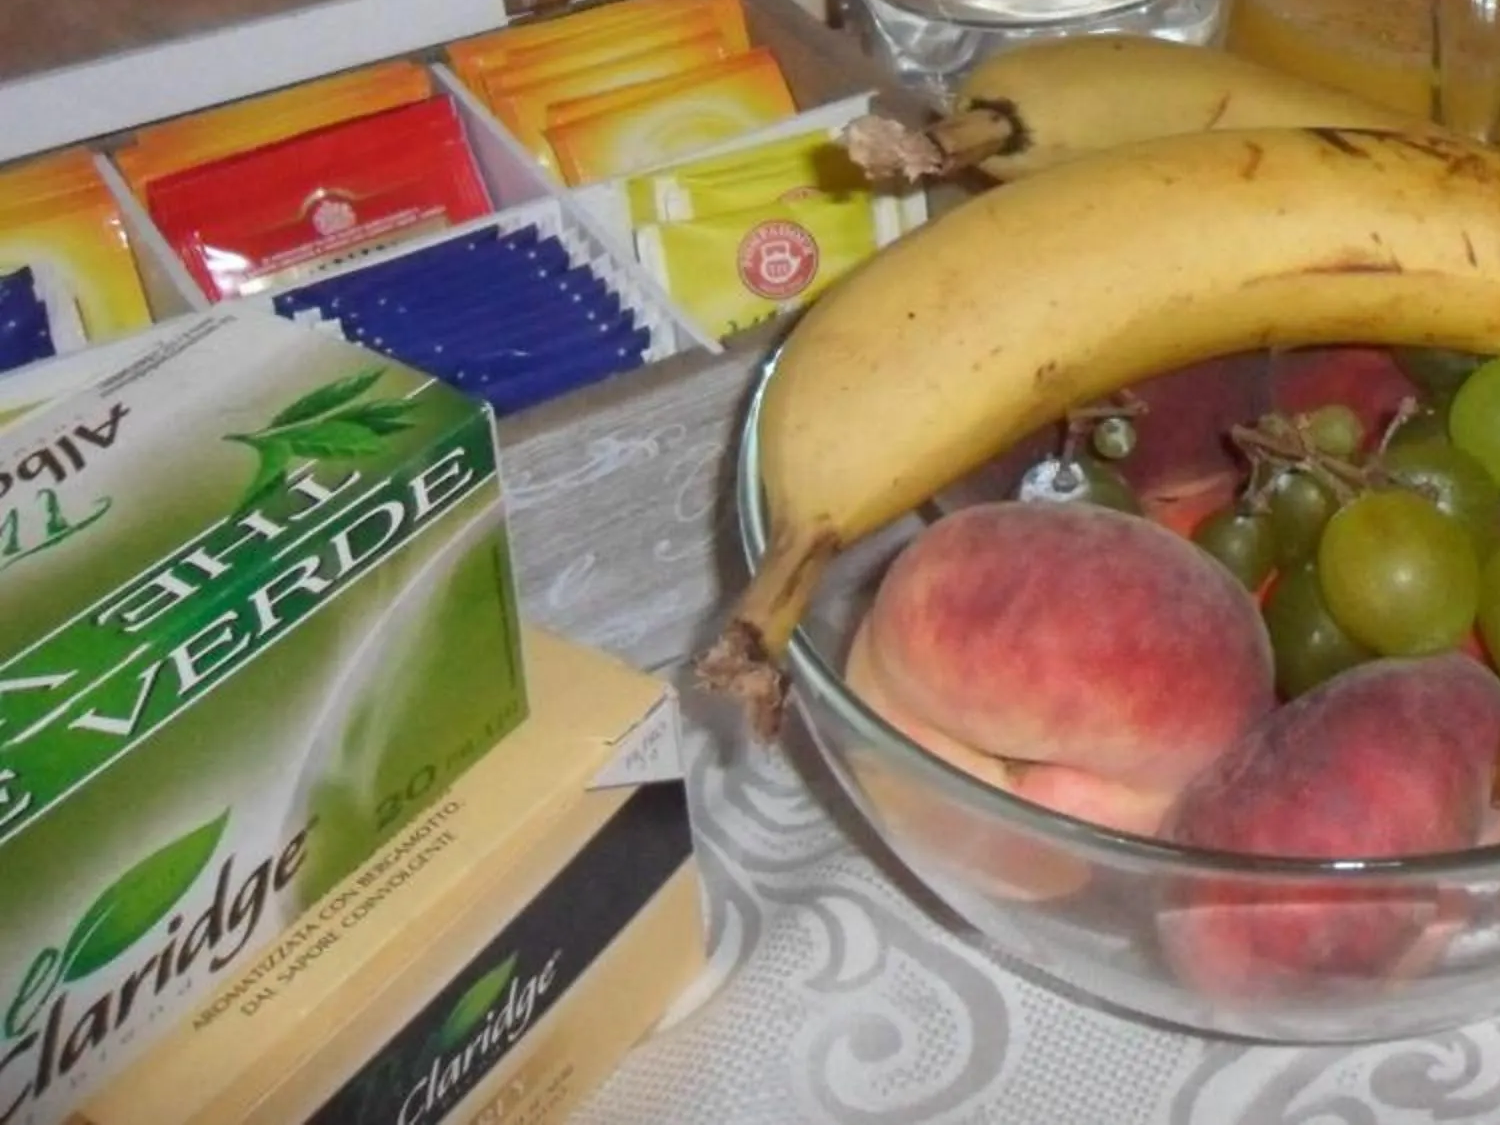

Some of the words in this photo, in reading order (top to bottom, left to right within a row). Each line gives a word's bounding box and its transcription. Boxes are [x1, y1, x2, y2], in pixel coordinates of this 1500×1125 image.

[69, 446, 475, 737] VERDE
[95, 459, 361, 632] THE
[191, 921, 320, 1032] AROMATIZZATA
[318, 888, 359, 922] CON
[240, 986, 277, 1017] DAL
[277, 930, 341, 985] SAPORE
[397, 947, 563, 1125] Claridge
